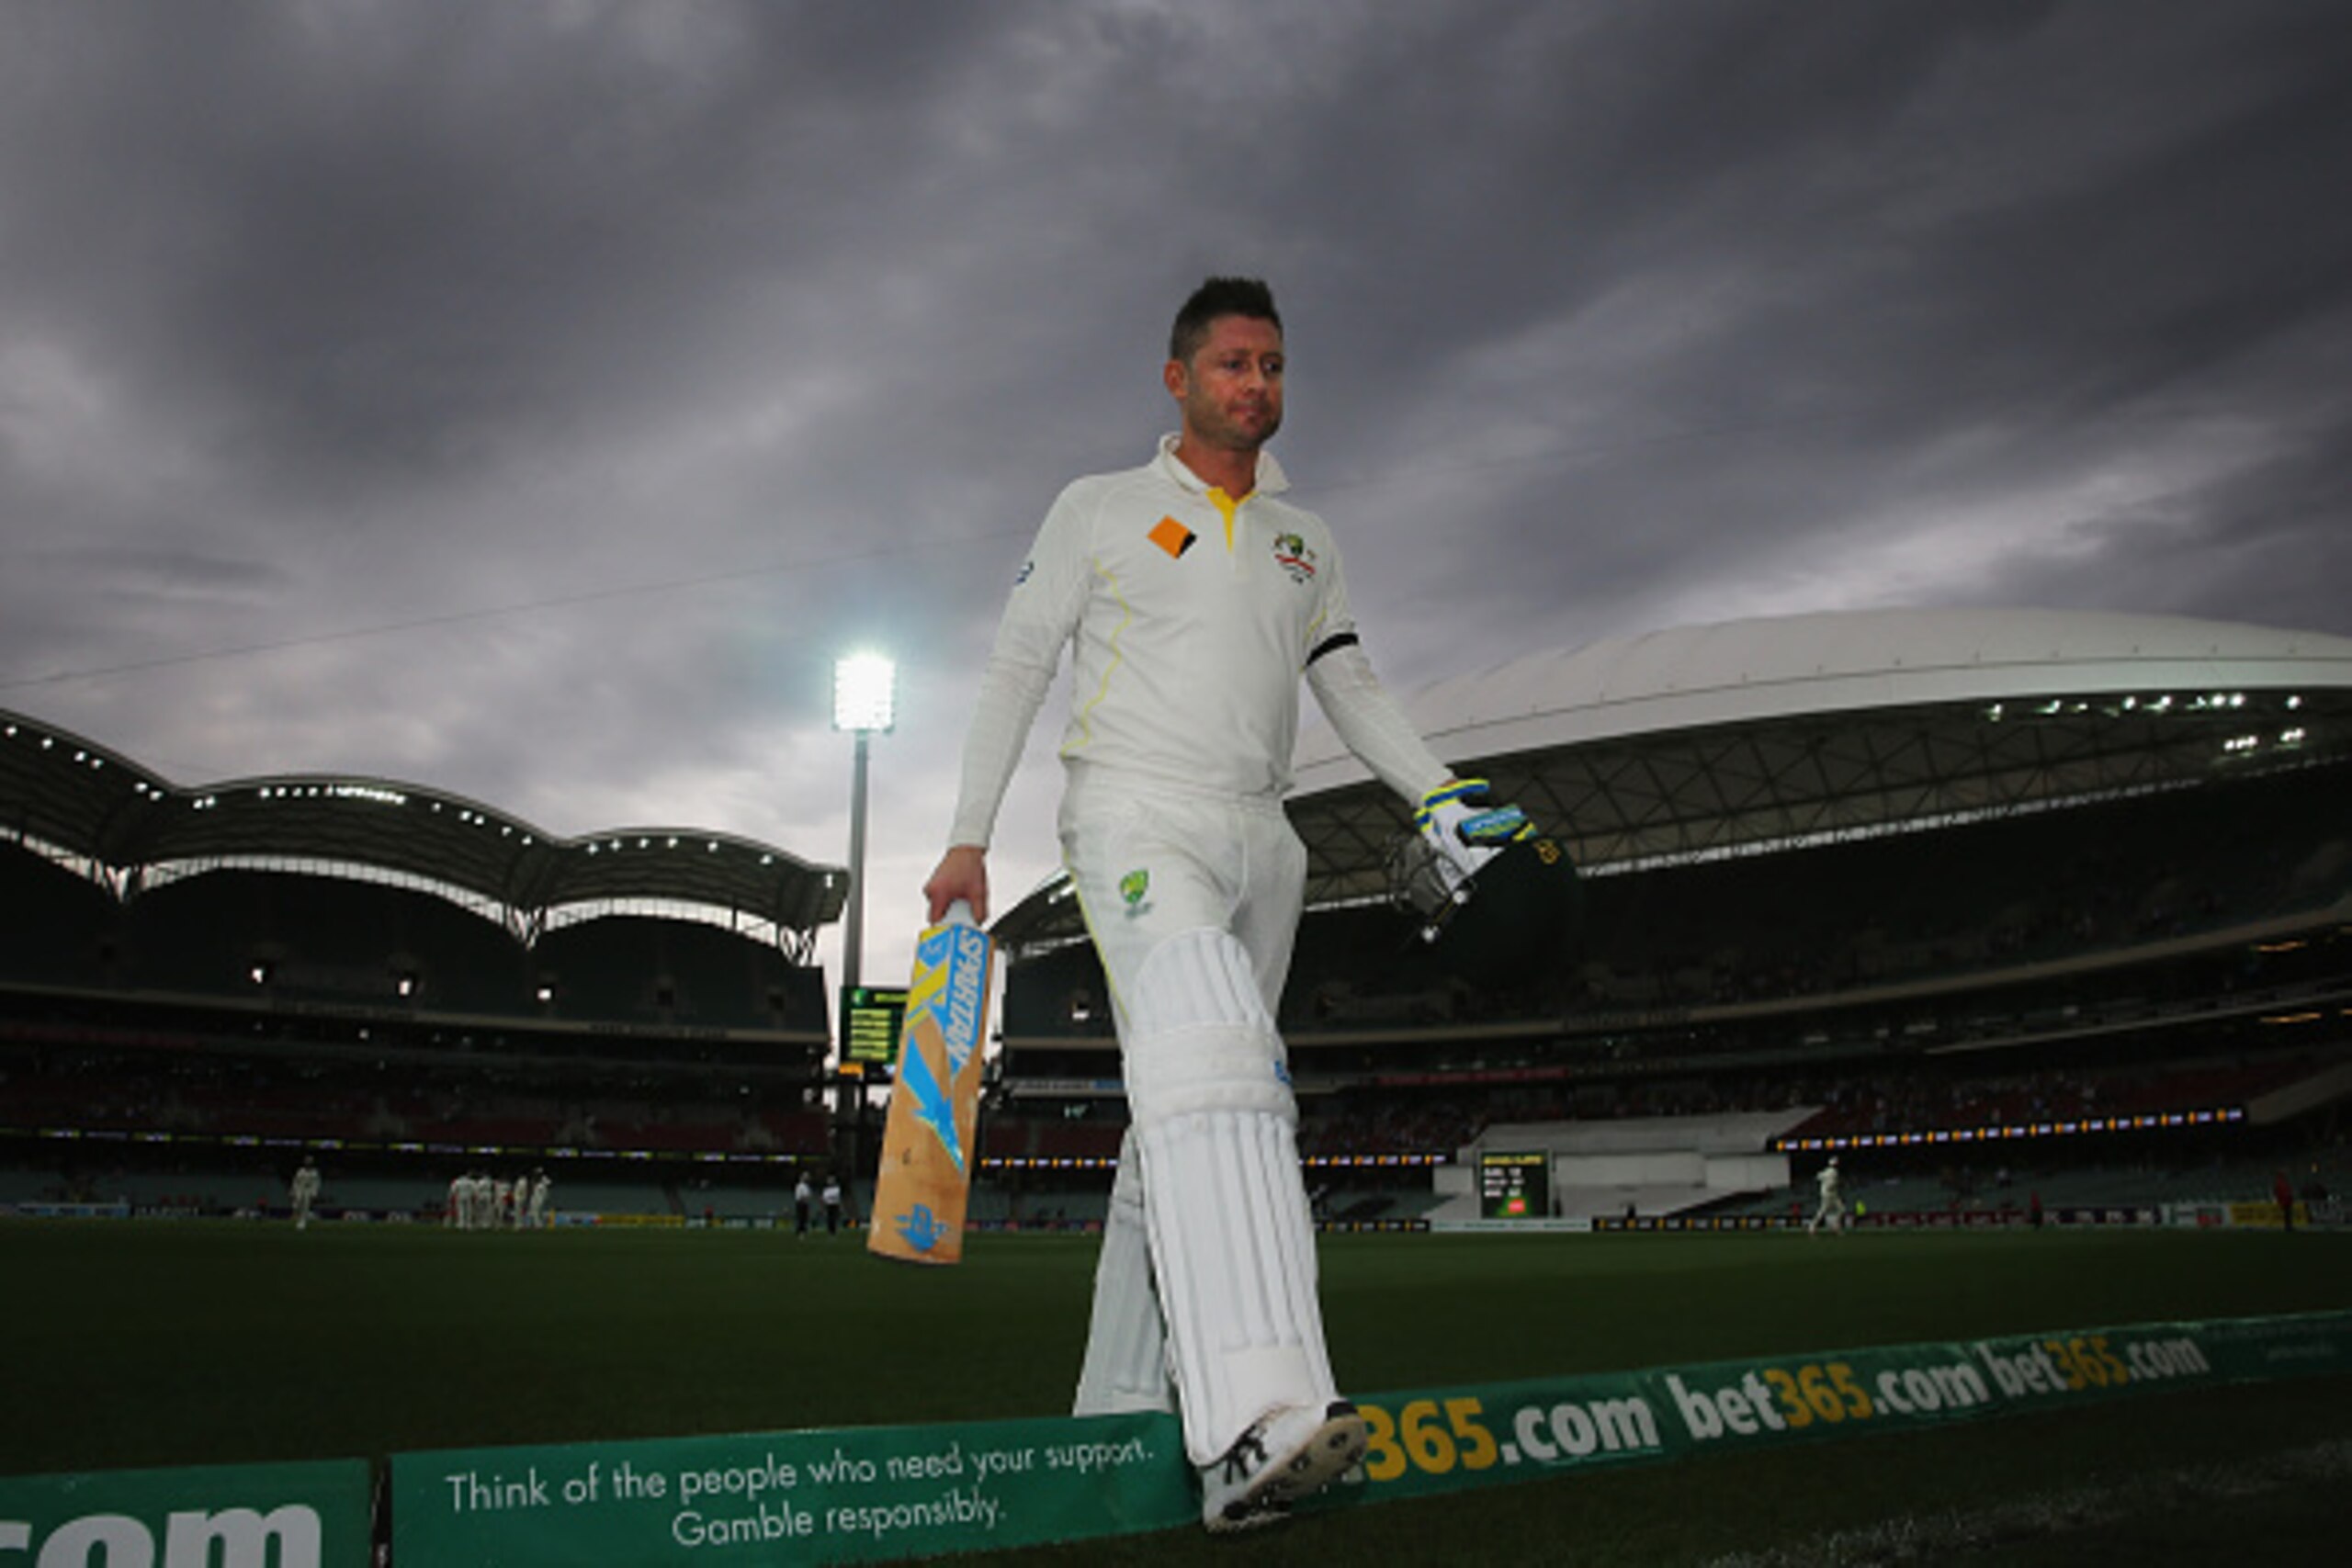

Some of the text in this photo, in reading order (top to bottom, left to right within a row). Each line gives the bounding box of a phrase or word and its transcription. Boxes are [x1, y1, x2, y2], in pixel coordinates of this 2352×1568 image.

[945, 930, 985, 1066] SPARTAN
[1345, 1337, 2211, 1483] 365.com bet365.com bet365.com
[445, 1438, 1155, 1512] Think of the people who need your support.
[672, 1485, 1008, 1547] Gamble responsibly.
